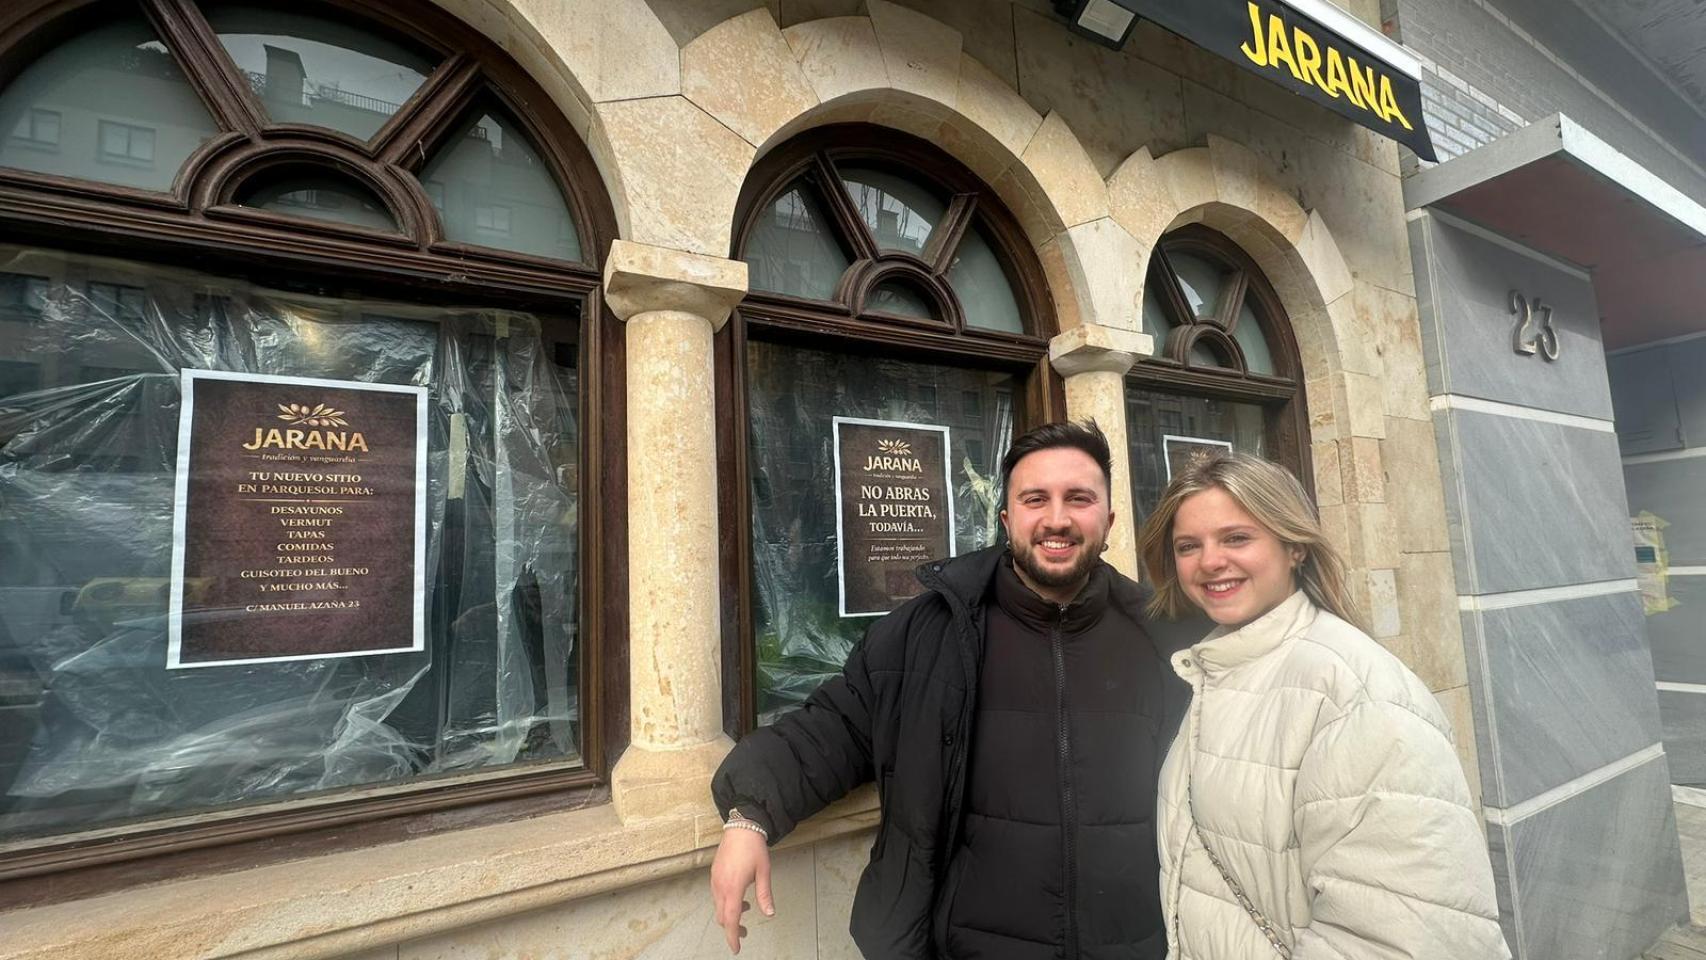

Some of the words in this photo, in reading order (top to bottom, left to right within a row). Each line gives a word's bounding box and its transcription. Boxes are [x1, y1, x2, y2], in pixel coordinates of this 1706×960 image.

[1240, 1, 1414, 131] JARANA
[1508, 289, 1560, 362] 23
[242, 427, 369, 452] JARANA
[863, 455, 923, 473] JARANA
[249, 471, 271, 481] TU
[273, 472, 323, 482] NUEVO
[325, 473, 362, 483] SITIO
[238, 483, 257, 493] EN
[261, 484, 338, 495] PARQUESOL
[340, 486, 374, 495] PARA:
[861, 485, 883, 500] NO
[885, 486, 930, 501] ABRAS
[271, 506, 343, 515] DESAYUNOS
[859, 503, 878, 517] LA
[880, 504, 937, 520] PUERTA,
[280, 518, 333, 527] VERMUT
[287, 530, 325, 539] TAPAS
[277, 542, 335, 551] COMIDAS
[276, 555, 334, 564] TARDEOS
[240, 569, 303, 578] GUISOTEO
[304, 569, 328, 577] DEL
[329, 567, 369, 576] BUENO
[259, 584, 267, 592] Y
[270, 583, 313, 592] MUCHO
[245, 604, 258, 612] C/
[260, 602, 307, 611] MANUEL
[308, 599, 347, 610] AZAÑA
[347, 600, 360, 608] 23
